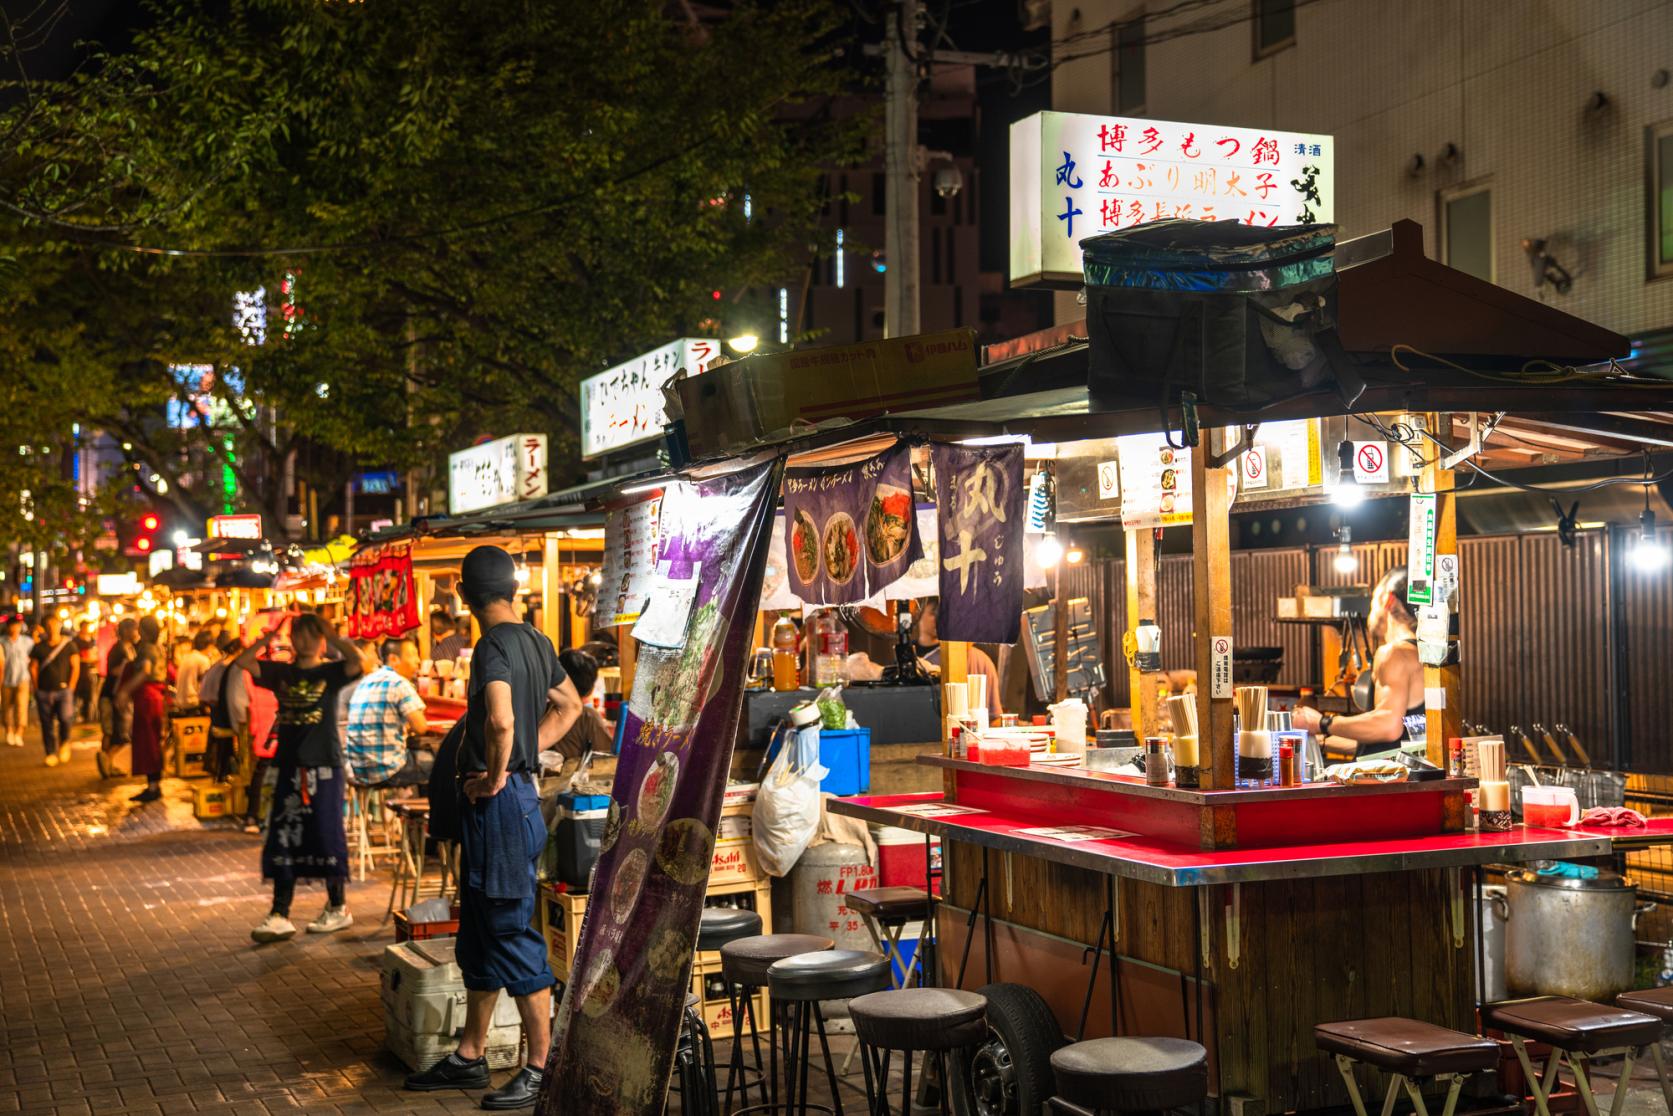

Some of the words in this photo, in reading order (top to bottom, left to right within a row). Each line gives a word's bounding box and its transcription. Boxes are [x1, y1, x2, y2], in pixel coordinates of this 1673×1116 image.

[1097, 123, 1281, 166] 博多もつ鍋
[1294, 143, 1321, 157] 清酒
[1056, 151, 1083, 238] 丸十
[1098, 160, 1280, 199] あぶり明太子
[1099, 198, 1280, 228] 博多長浜ラメン
[523, 437, 541, 496] ラーメン
[943, 460, 1007, 596] 丸十
[993, 535, 1005, 587] じゅう
